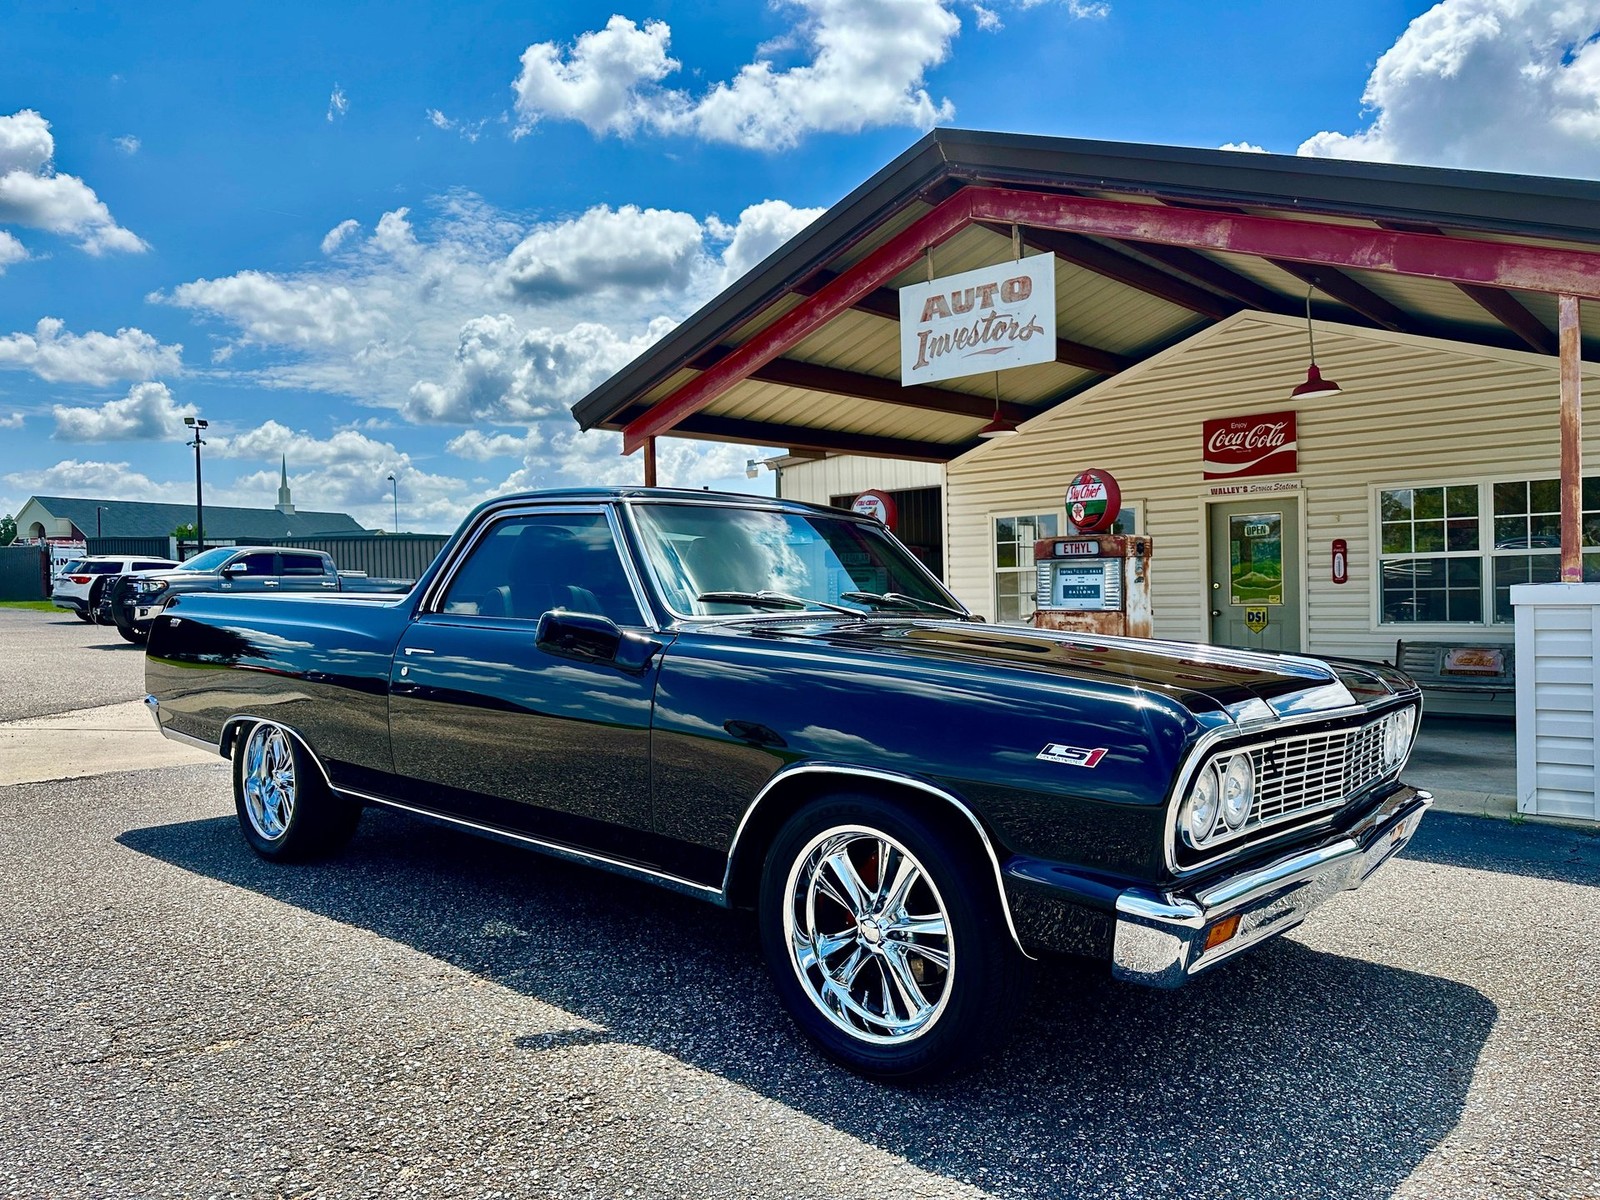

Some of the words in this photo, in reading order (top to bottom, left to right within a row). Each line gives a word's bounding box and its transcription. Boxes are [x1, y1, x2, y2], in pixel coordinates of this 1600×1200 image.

[920, 275, 1032, 323] AUTO
[912, 310, 1045, 370] Investors
[1208, 421, 1289, 453] Coca-Cola
[1080, 484, 1102, 499] Chief
[1210, 485, 1248, 495] WALLEY'S
[1249, 484, 1273, 493] Service
[1273, 483, 1298, 491] Station
[1246, 525, 1267, 536] OPEN
[1063, 542, 1092, 555] ETHYL
[1247, 611, 1266, 623] DSI
[1041, 744, 1106, 767] LS1
